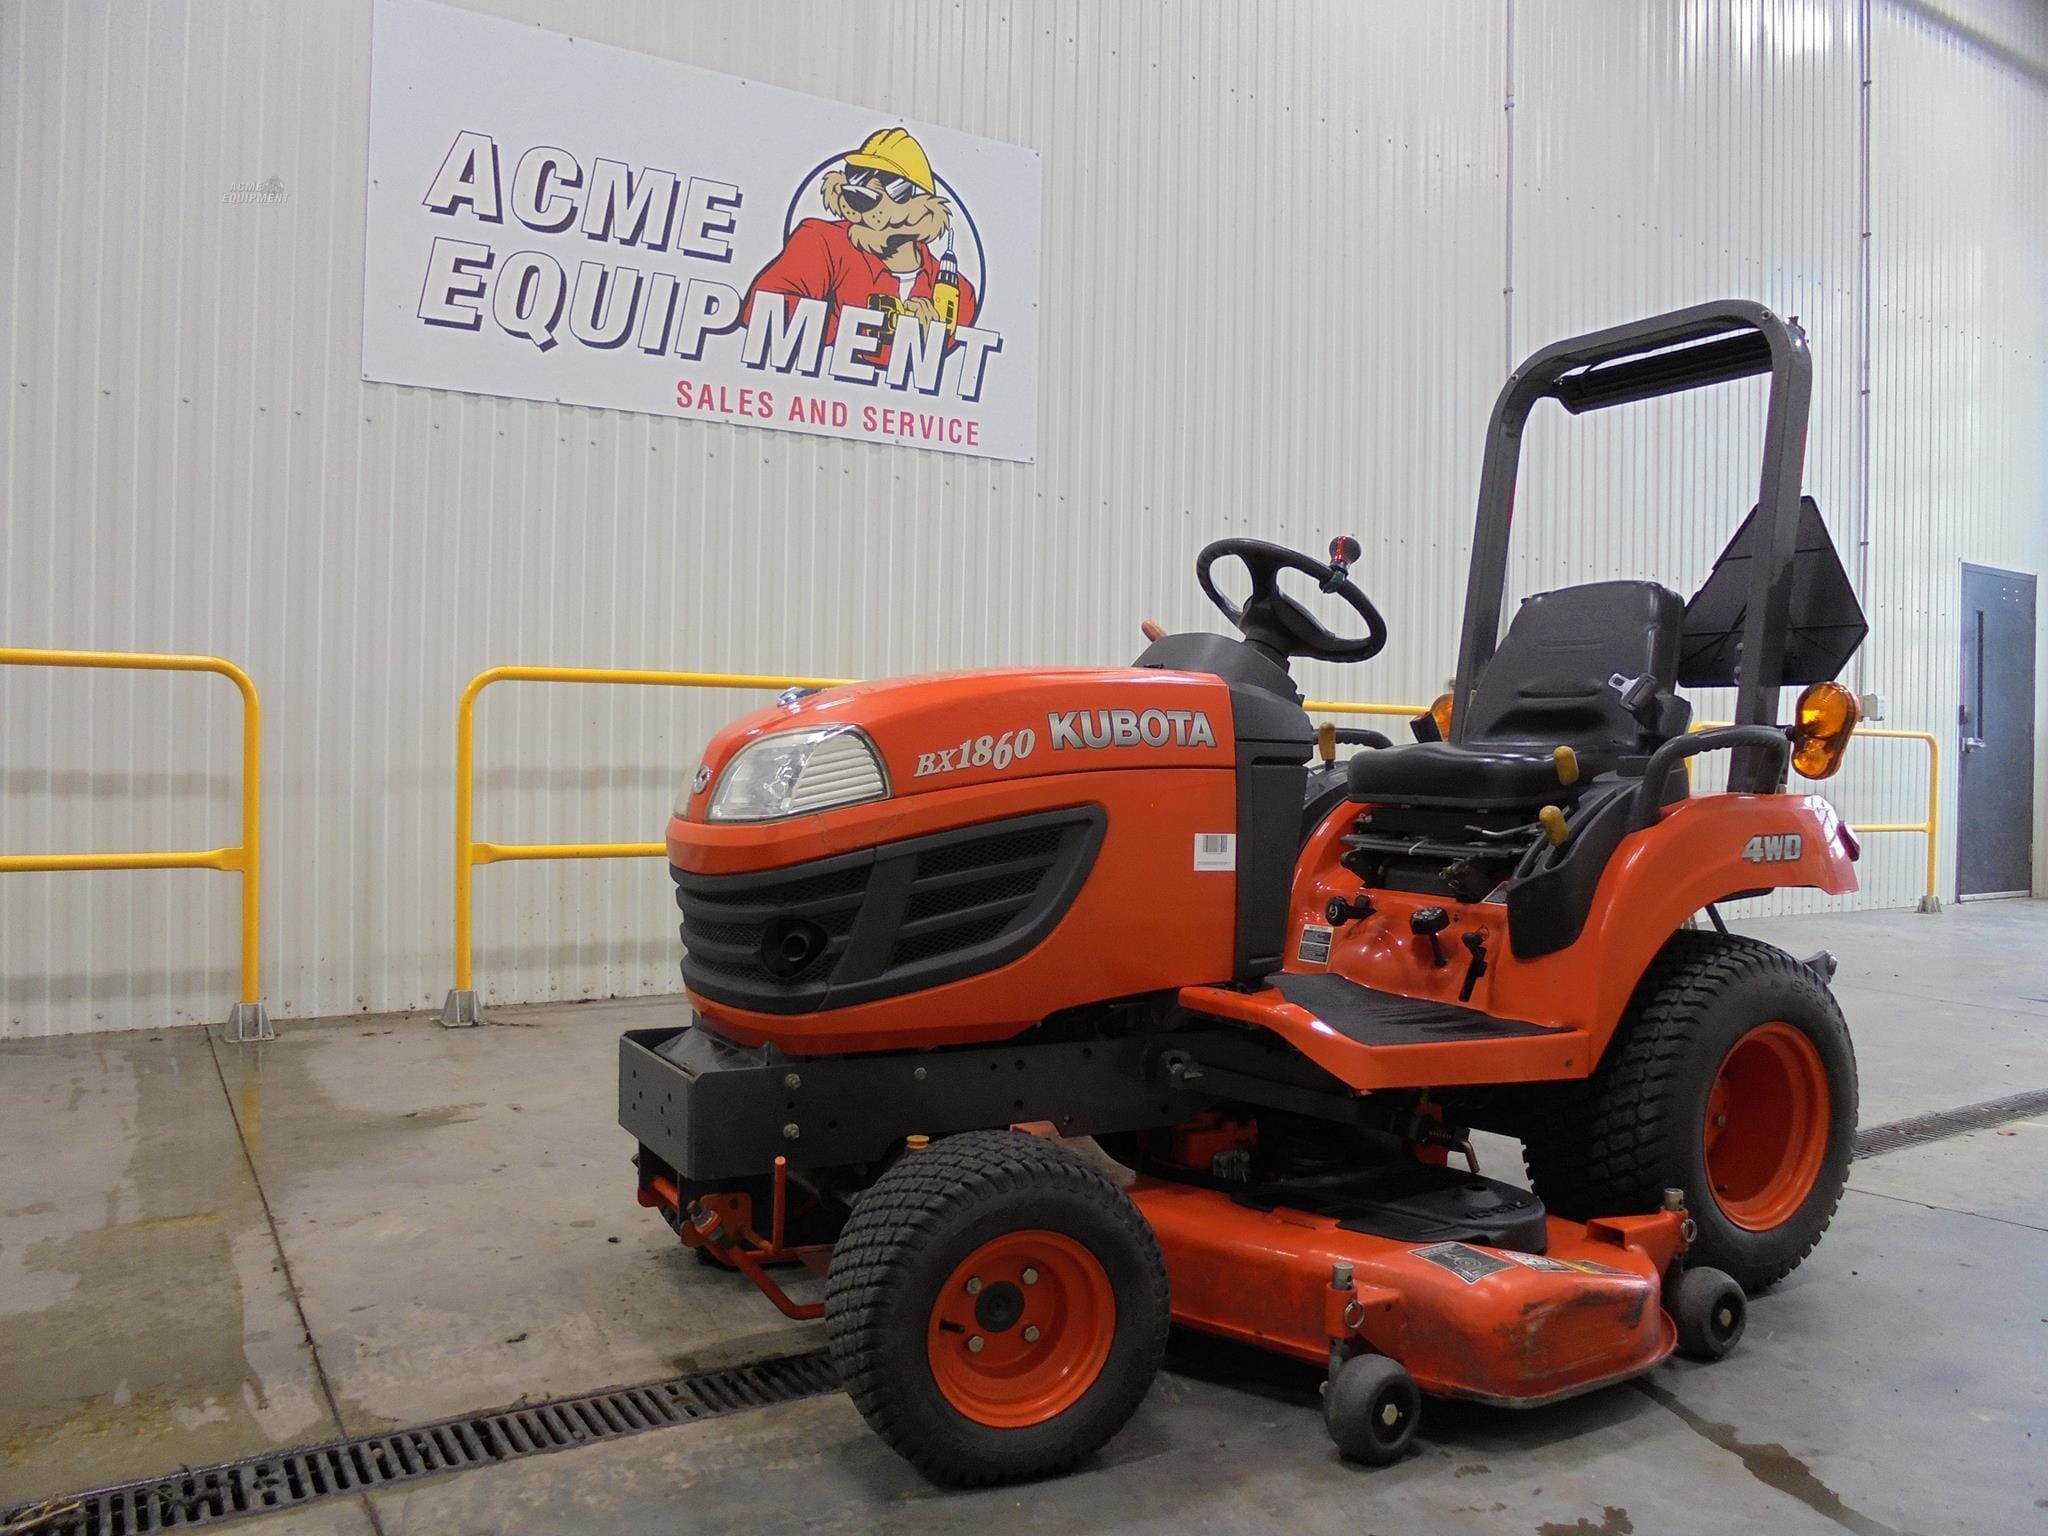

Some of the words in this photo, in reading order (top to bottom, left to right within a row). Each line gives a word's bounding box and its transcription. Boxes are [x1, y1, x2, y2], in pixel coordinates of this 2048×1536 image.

[423, 130, 742, 262] ACME
[417, 236, 1003, 403] EQUIPMENT
[676, 380, 774, 418] SALES
[788, 396, 848, 428] AND
[863, 406, 979, 446] SERVICE
[913, 728, 1036, 778] BX1860
[1048, 709, 1217, 751] KUBOTA
[1741, 833, 1802, 864] 4WD
